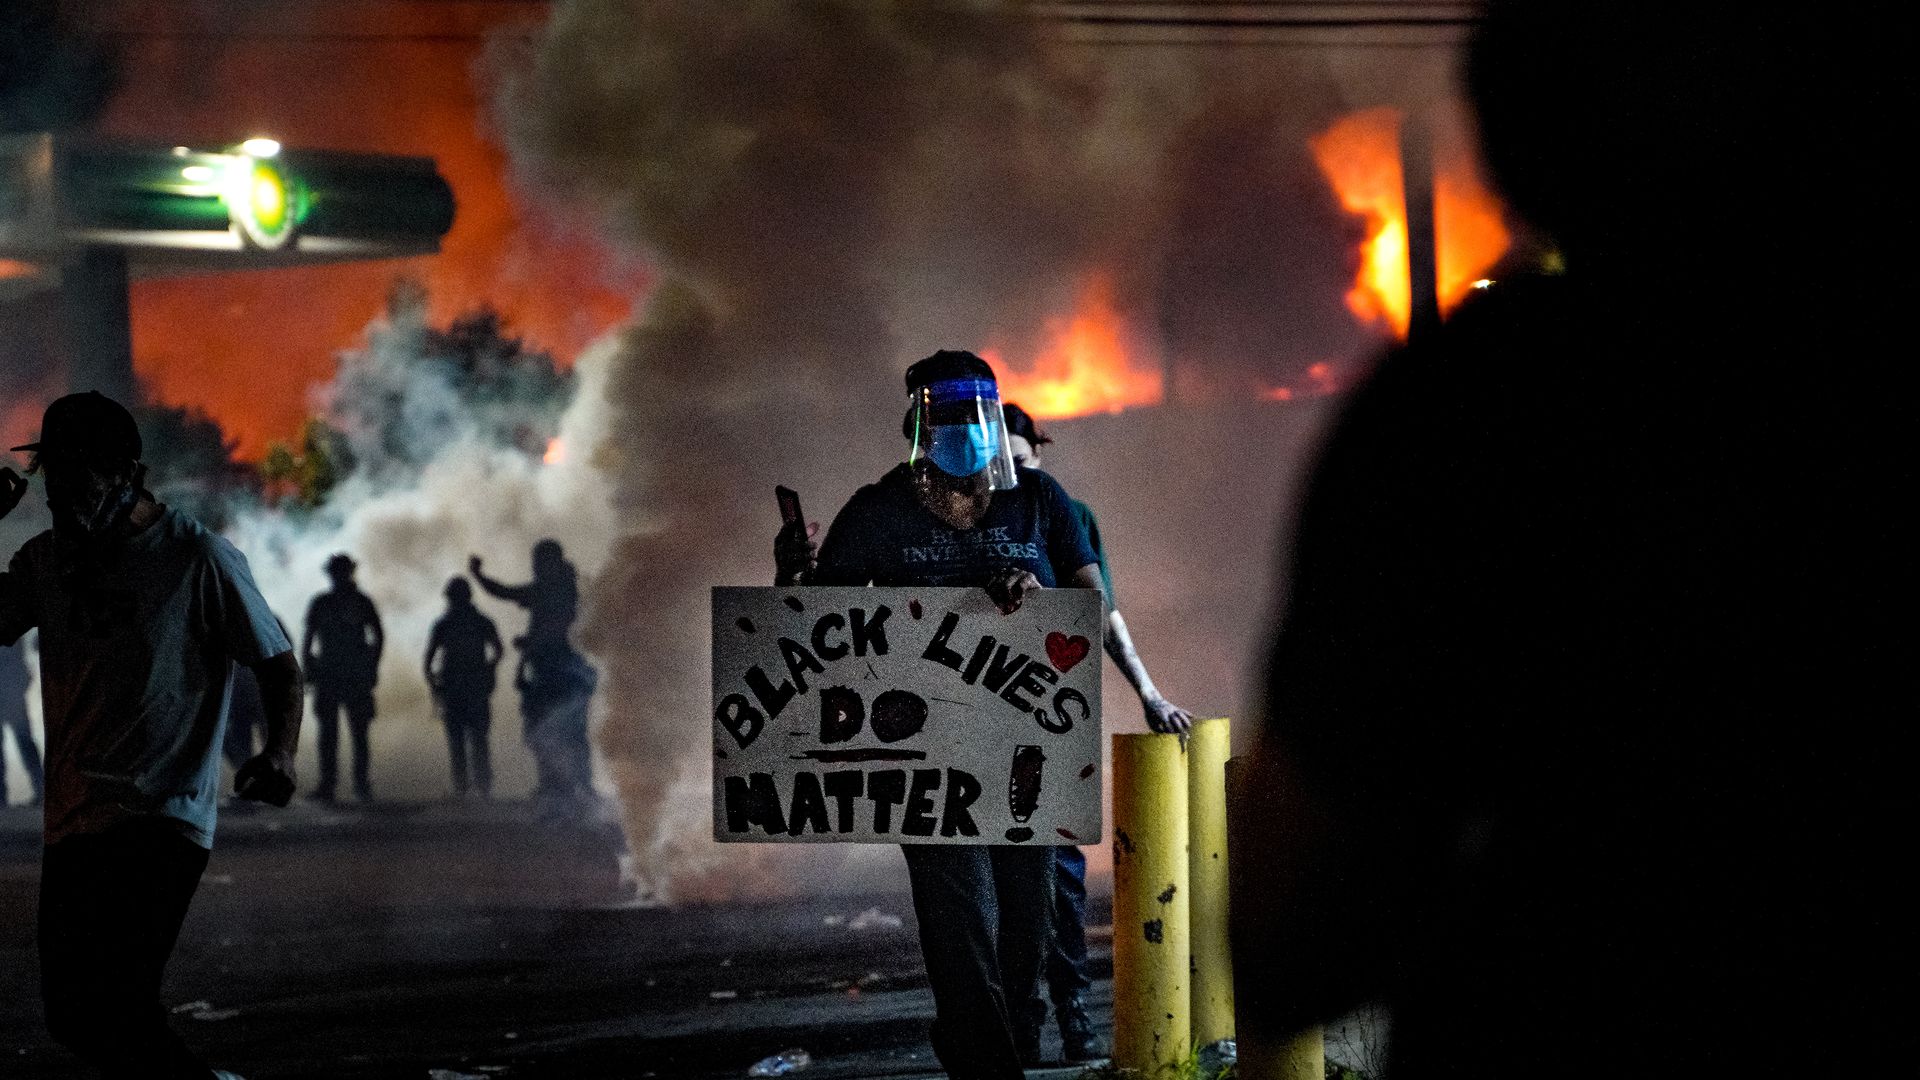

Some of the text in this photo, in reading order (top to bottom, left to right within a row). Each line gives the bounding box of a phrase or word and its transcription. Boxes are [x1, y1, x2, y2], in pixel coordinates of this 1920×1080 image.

[902, 542, 1040, 563] INVETORS
[715, 604, 1090, 750] BLACK LIVES
[819, 685, 929, 744] DO
[724, 767, 983, 837] MATTER
